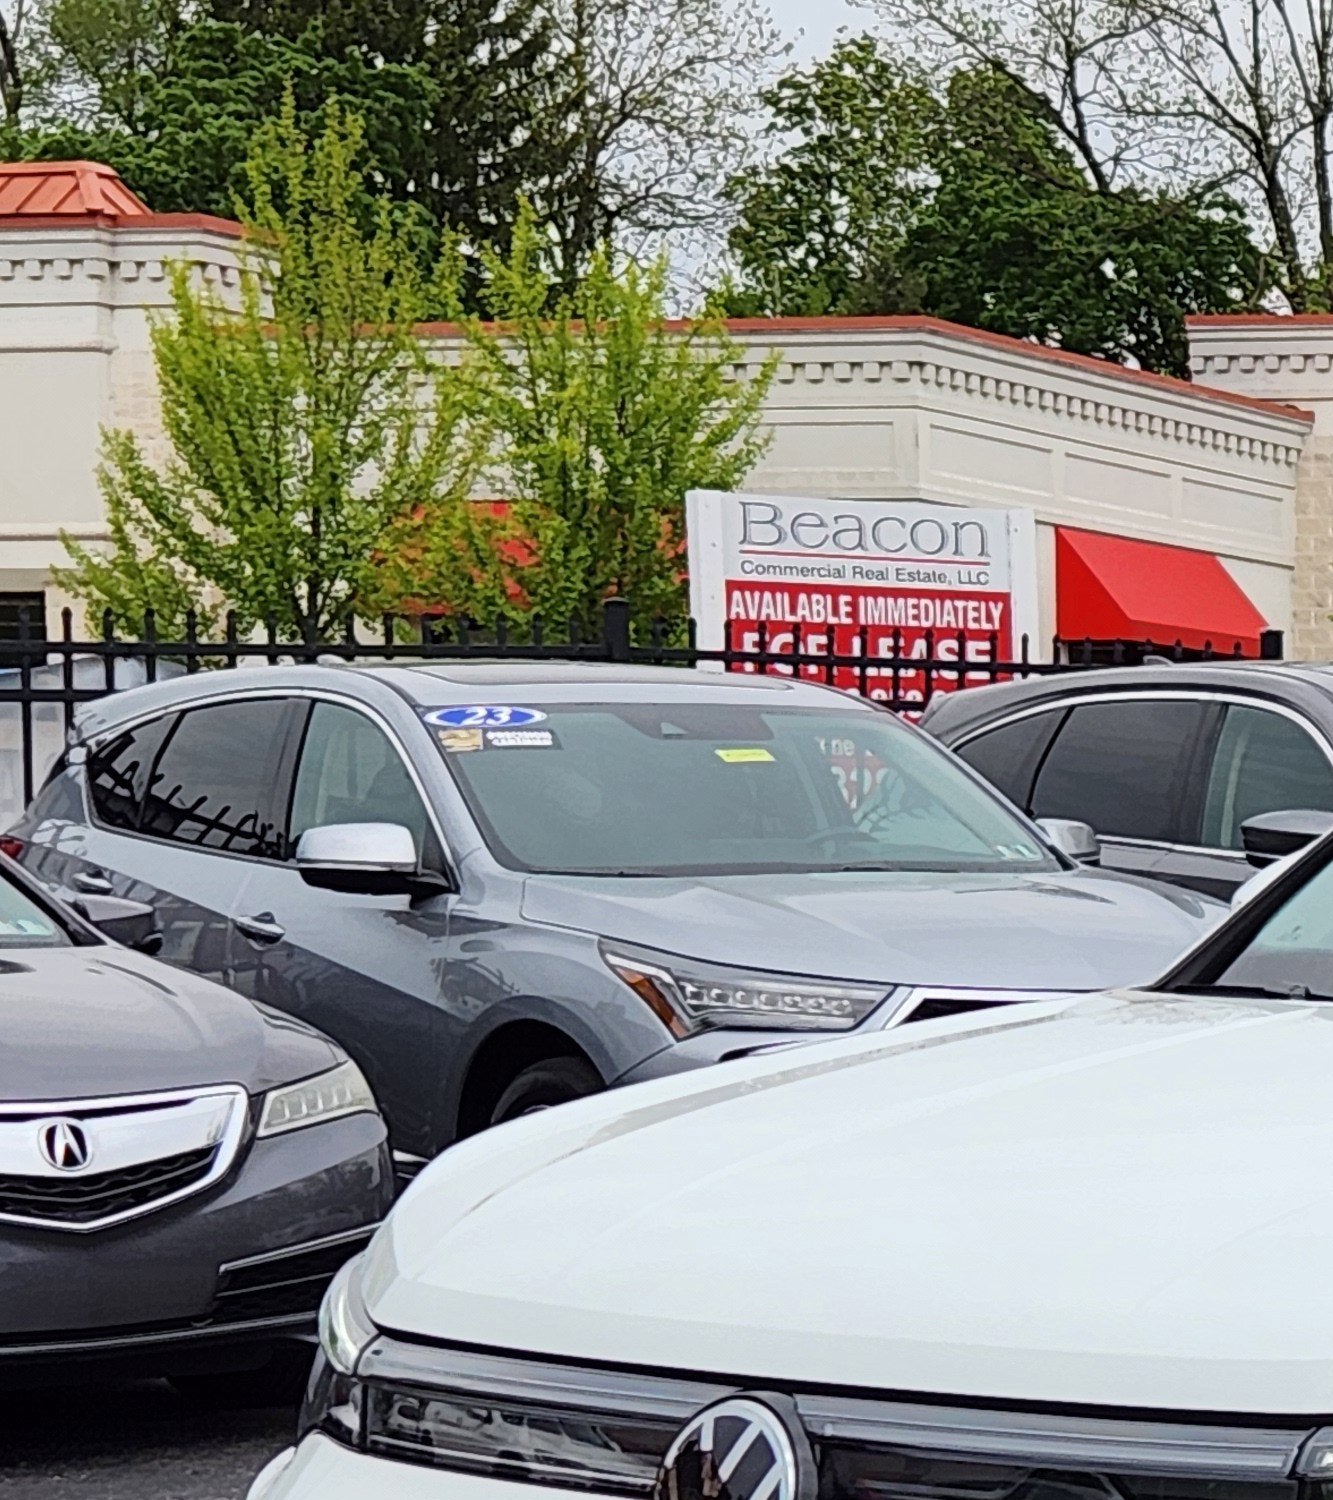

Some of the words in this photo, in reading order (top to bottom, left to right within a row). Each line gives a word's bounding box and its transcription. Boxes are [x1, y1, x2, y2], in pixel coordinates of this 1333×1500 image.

[738, 501, 991, 558] Beacon
[740, 559, 846, 580] Commercial
[852, 565, 890, 582] Real
[895, 567, 952, 586] Estate,
[957, 570, 990, 586] LLC
[729, 590, 853, 625] AVAILABLE
[858, 595, 1004, 631] IMMEDIATELY
[460, 706, 513, 726] 23
